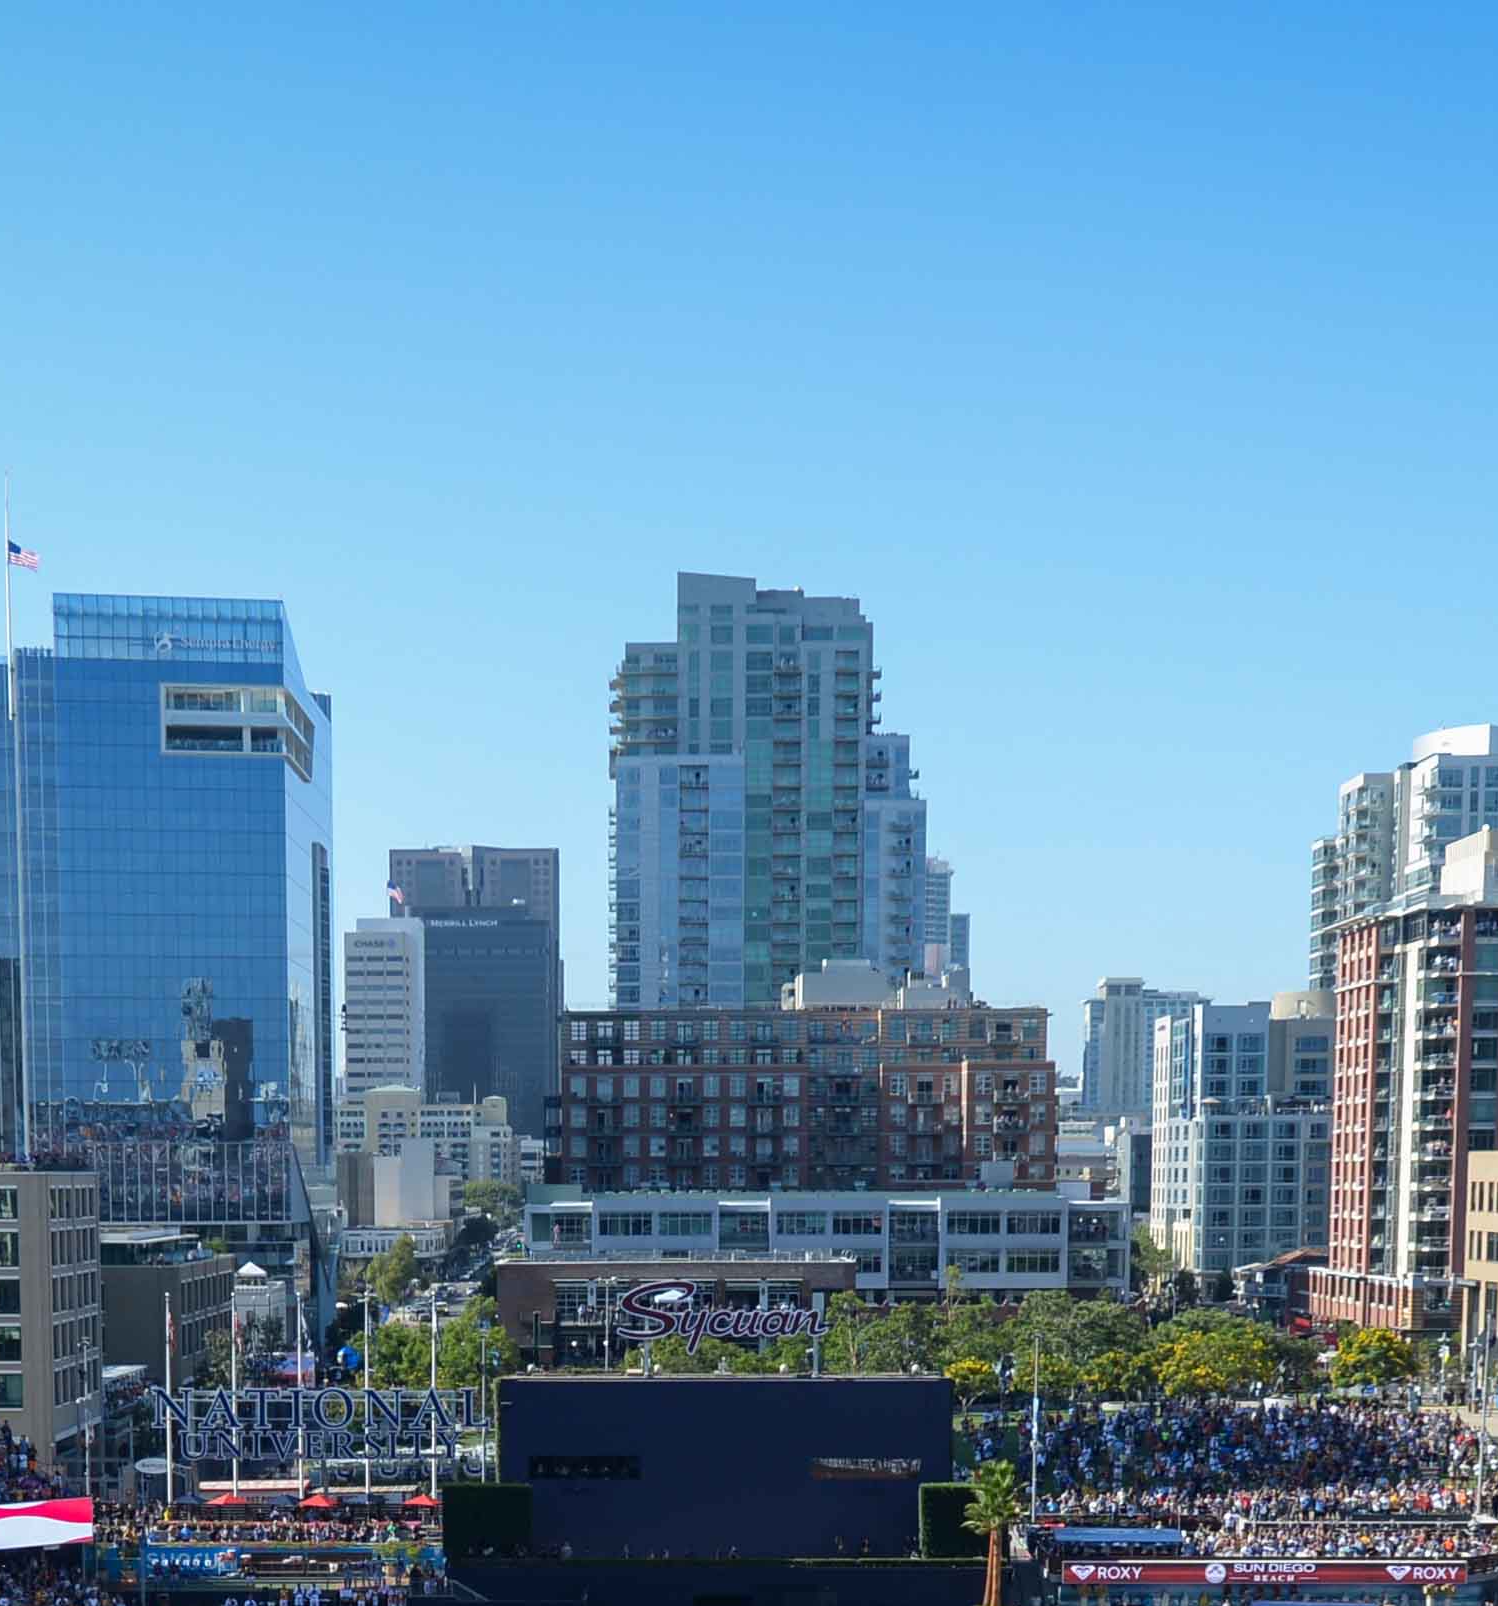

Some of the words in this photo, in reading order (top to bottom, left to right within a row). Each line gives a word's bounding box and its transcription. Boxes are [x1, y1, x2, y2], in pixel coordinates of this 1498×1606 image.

[469, 919, 498, 928] LYNCH
[354, 939, 384, 948] CHASE
[617, 1279, 831, 1357] Sycuan
[152, 1385, 491, 1430] NATIONAL
[178, 1430, 463, 1461] UNIVERSITY
[1097, 1566, 1143, 1580] ROXY
[1233, 1562, 1266, 1574] SUN
[1268, 1562, 1316, 1574] DIEGO
[1413, 1566, 1459, 1580] ROXY
[1254, 1574, 1296, 1582] BEACH
